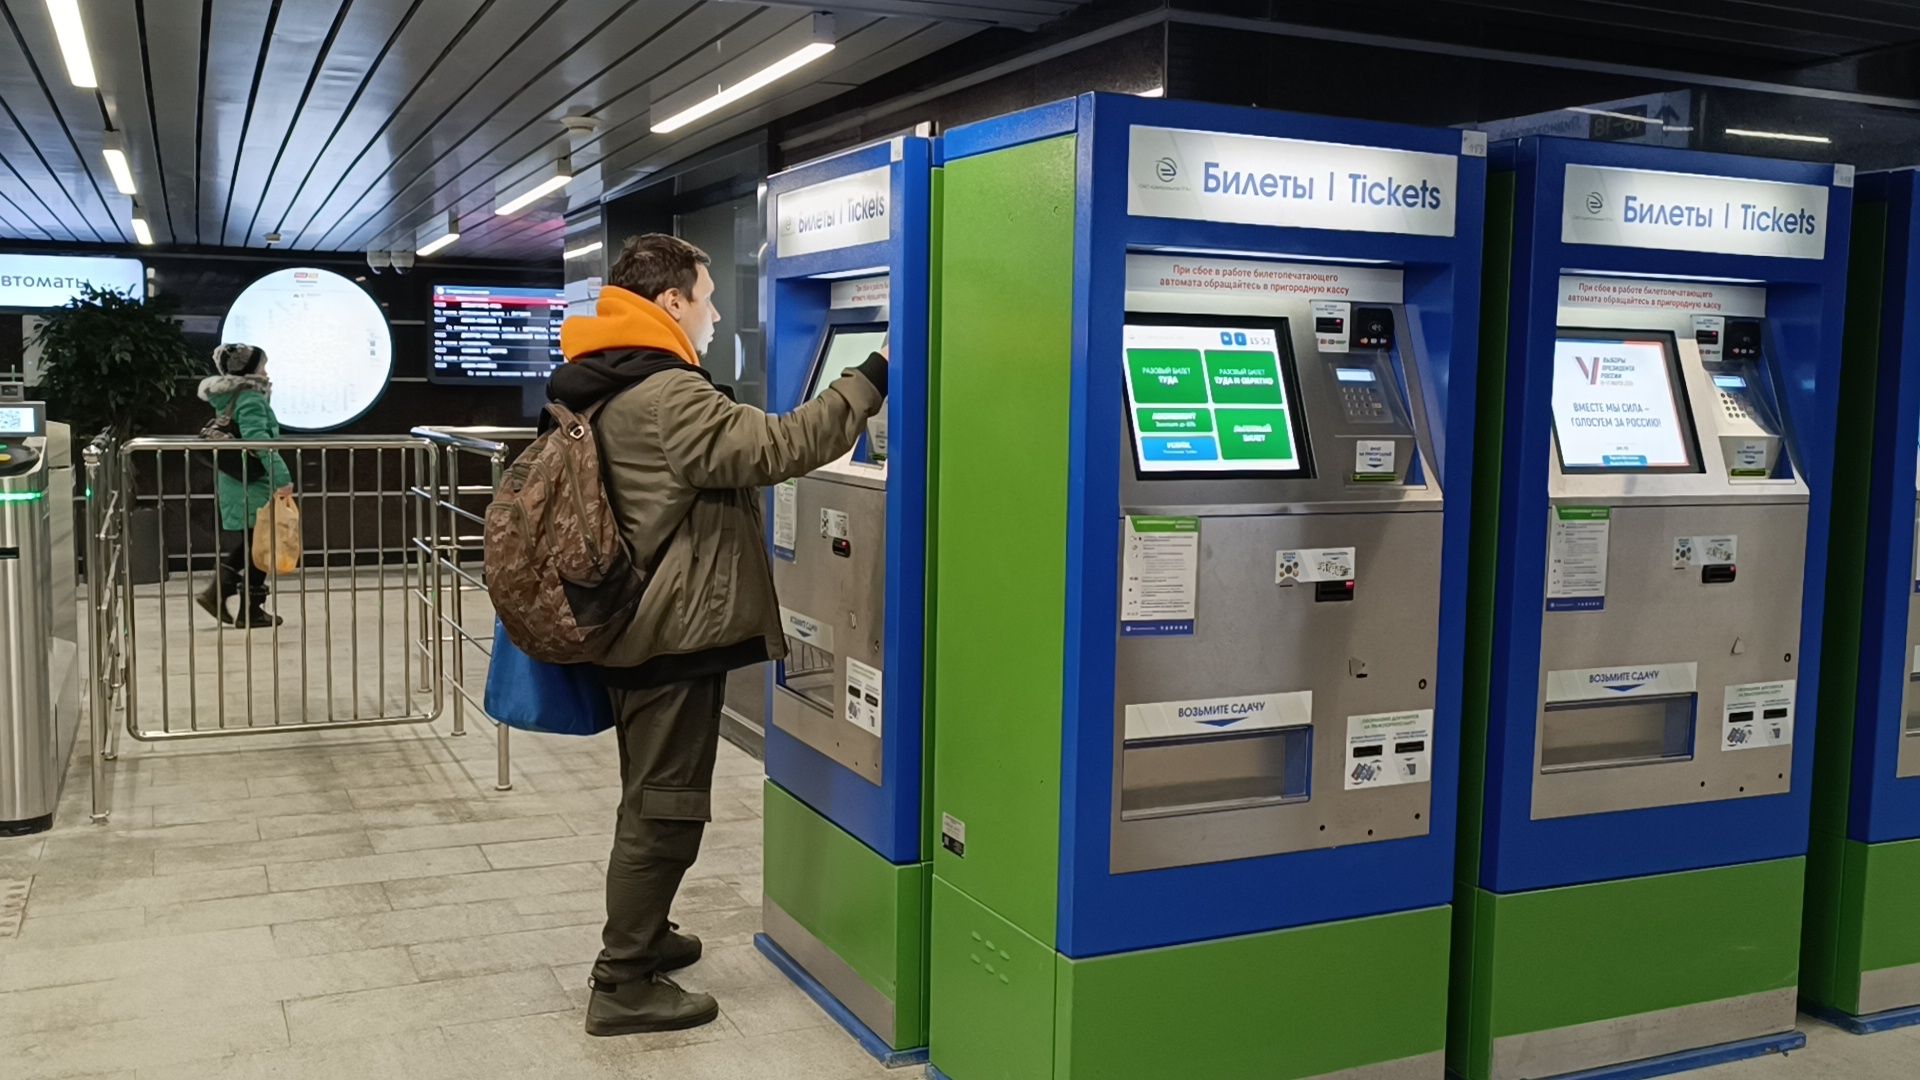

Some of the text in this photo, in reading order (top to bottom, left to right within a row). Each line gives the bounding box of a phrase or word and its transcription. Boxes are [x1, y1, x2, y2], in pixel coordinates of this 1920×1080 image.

[1203, 162, 1314, 200] Билеты
[1348, 173, 1441, 210] Tickets
[847, 192, 885, 223] Tickets
[1623, 195, 1713, 228] Билеты
[1741, 204, 1816, 235] Tickets
[1172, 264, 1339, 283] При сбое в работе билетопечатающего
[1160, 278, 1202, 287] автомата
[1204, 279, 1262, 290] обращайтесь
[1270, 283, 1325, 295] пригородную
[1326, 286, 1350, 296] кассу
[1578, 282, 1593, 293] При
[1594, 284, 1611, 293] сбое
[1618, 286, 1642, 296] работе
[1568, 294, 1602, 303] автомата
[1603, 295, 1649, 305] обращайтесь
[1657, 299, 1701, 310] пригородную
[1703, 302, 1722, 311] кассу
[1250, 336, 1271, 345] 1552
[1158, 375, 1179, 386] ТУДА
[1214, 376, 1234, 386] ТУДА
[1573, 402, 1605, 413] ВМЕСТЕ
[1606, 403, 1621, 413] МЫ
[1621, 403, 1644, 413] СИЛА
[1571, 417, 1662, 428] ГОЛОСУЕМ ЗА РОССИЮ!
[1589, 670, 1660, 683] ВОЗЬМИТЕ СДАЧУ
[1178, 701, 1265, 718] ВОЗЬМИТЕ СДАЧУ
